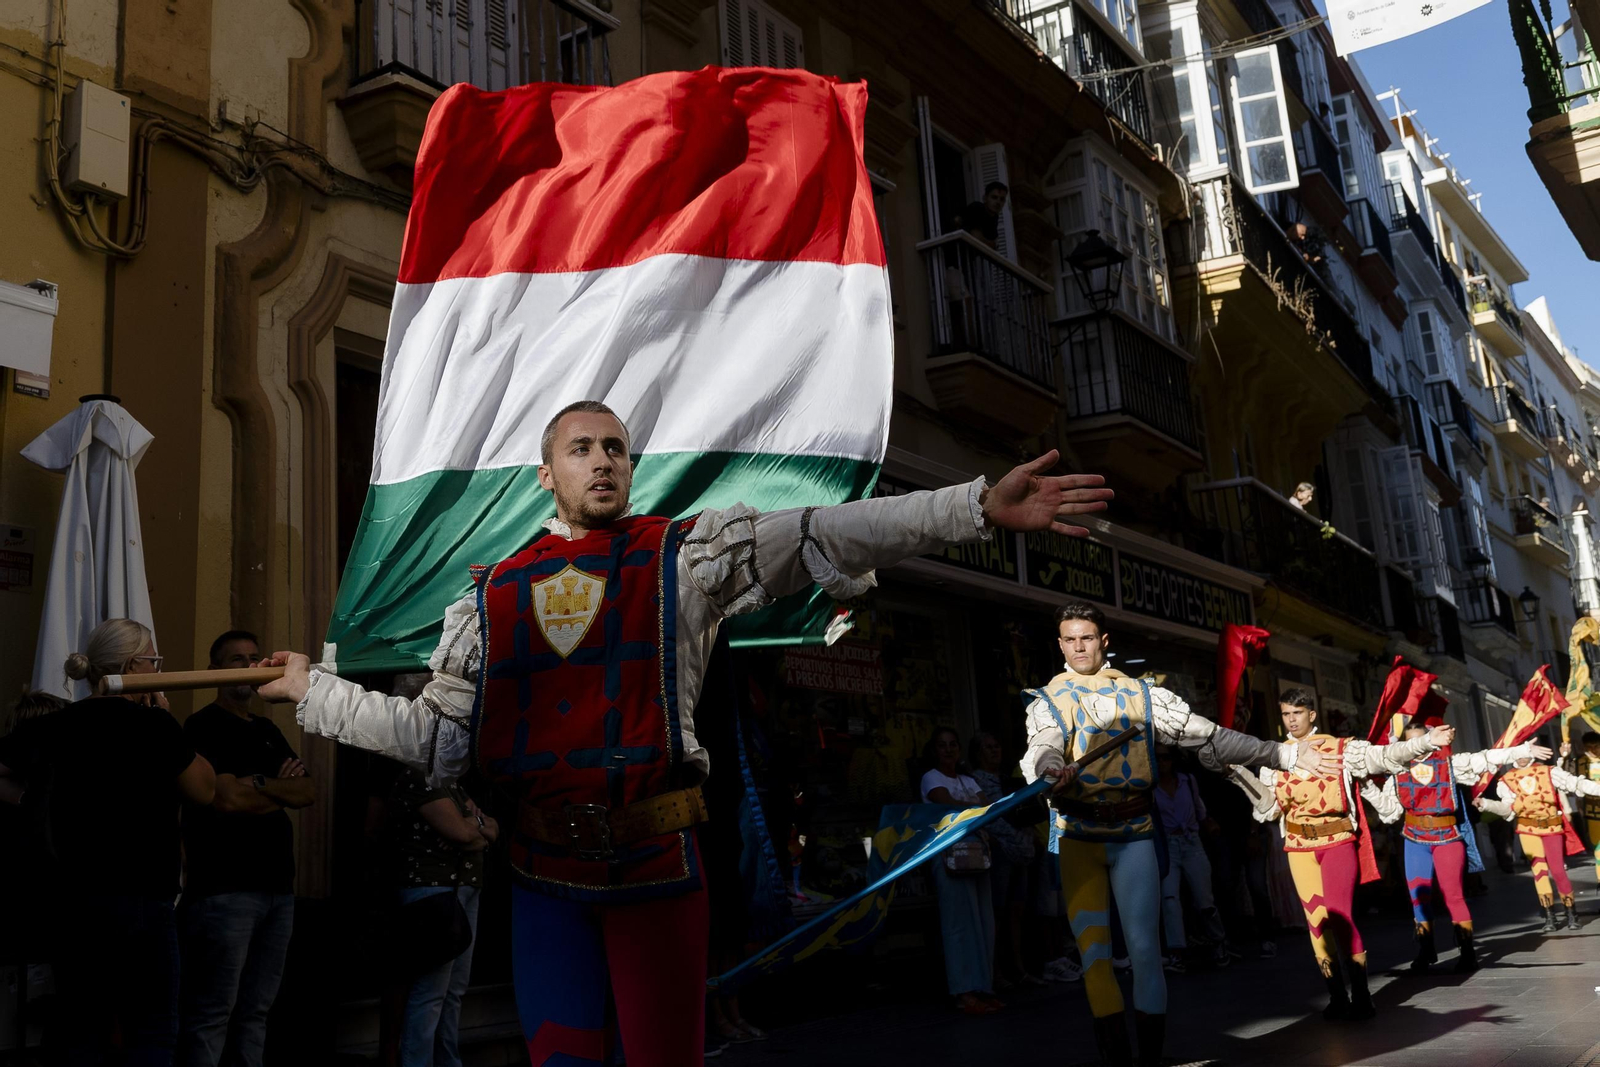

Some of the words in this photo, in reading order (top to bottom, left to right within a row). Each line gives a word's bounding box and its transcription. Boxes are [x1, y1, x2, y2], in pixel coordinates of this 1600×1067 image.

[1083, 542, 1113, 575] OFICIAL
[785, 655, 833, 675] DEPORTIVOS
[863, 666, 883, 681] SALA
[786, 669, 794, 684] A
[795, 670, 834, 689] PRECIOS
